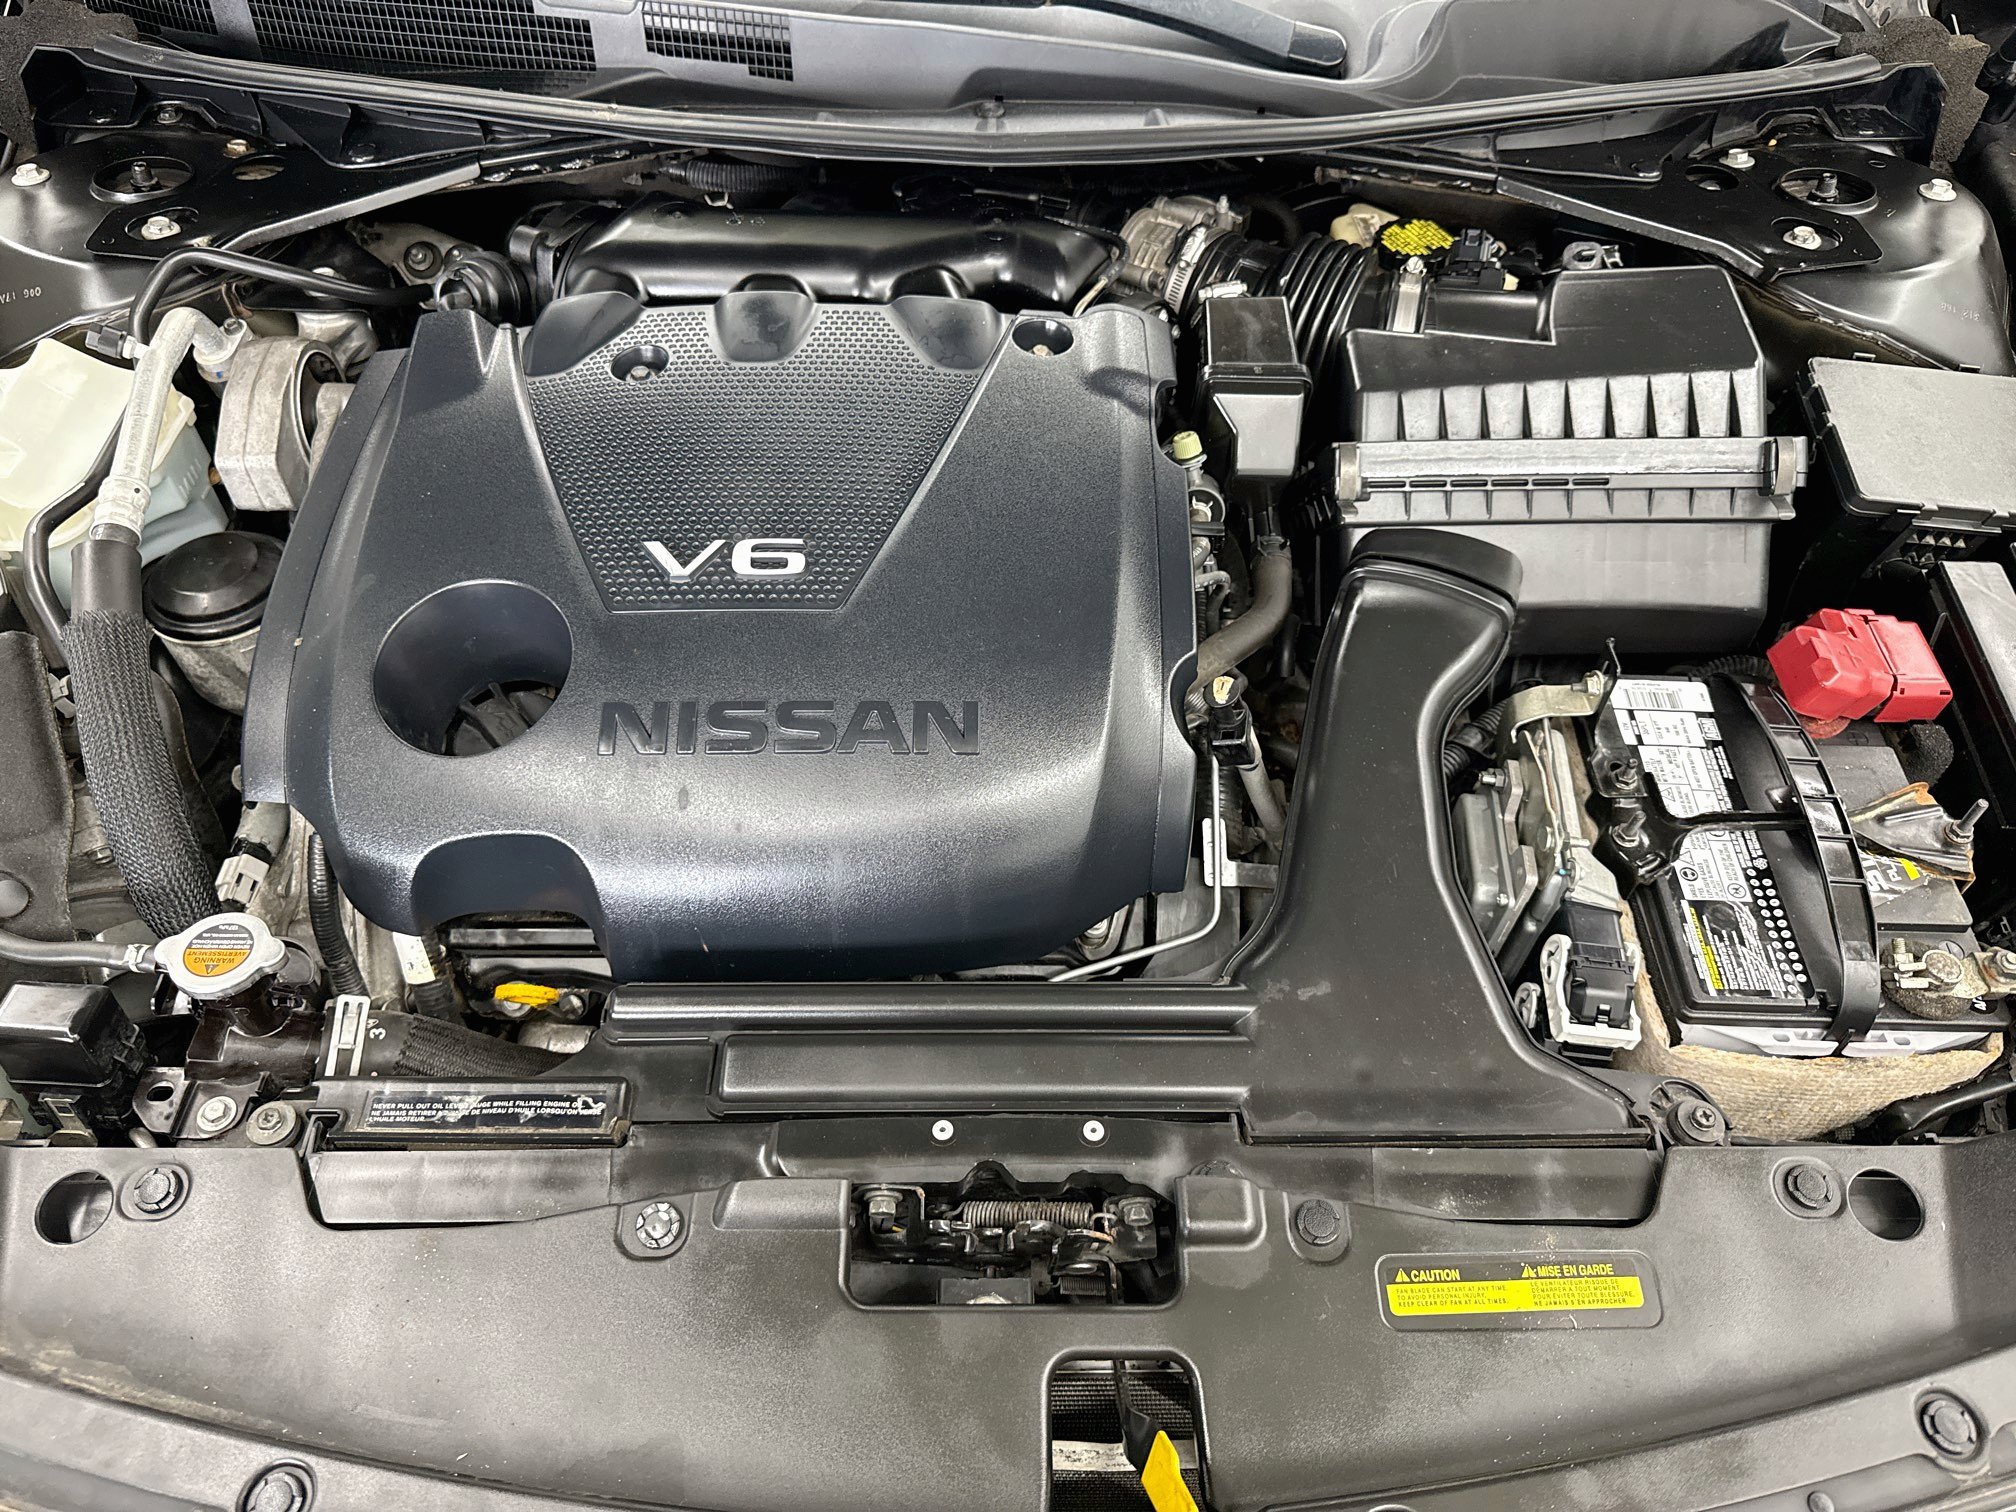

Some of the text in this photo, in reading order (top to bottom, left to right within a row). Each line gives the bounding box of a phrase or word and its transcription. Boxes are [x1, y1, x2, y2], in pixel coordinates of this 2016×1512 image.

[641, 537, 807, 582] V6
[596, 699, 981, 756] NISSAN
[193, 956, 235, 964] WARNING
[1410, 1268, 1461, 1282] CAUTION
[1536, 1263, 1615, 1277] MISE EN GARDE
[1540, 1279, 1583, 1287] VENTILATEUR
[1584, 1278, 1609, 1286] RISQUE
[1407, 1293, 1427, 1301] AVOID
[1577, 1291, 1598, 1299] TOUTE
